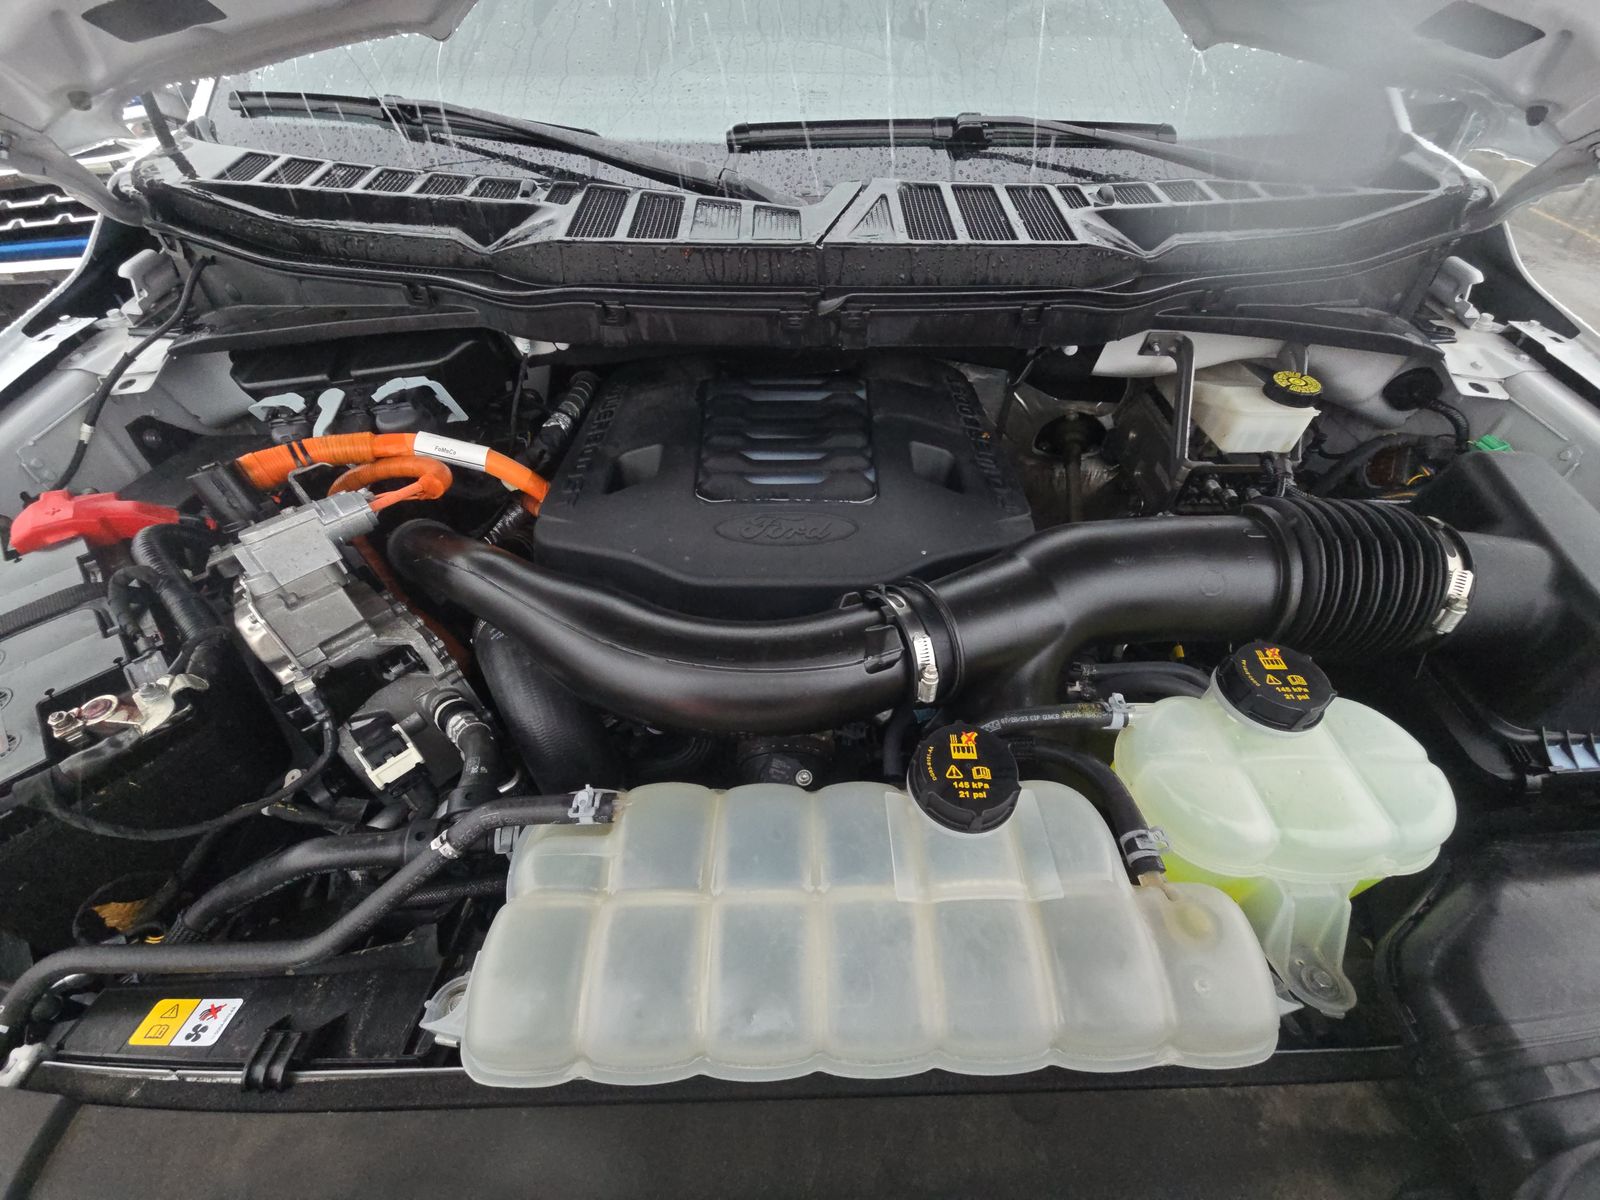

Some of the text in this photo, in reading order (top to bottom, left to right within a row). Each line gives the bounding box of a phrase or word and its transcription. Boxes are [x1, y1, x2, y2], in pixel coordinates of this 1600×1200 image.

[739, 514, 833, 541] Ford
[953, 781, 990, 789] 145 kPa
[959, 790, 987, 800] 21 psi
